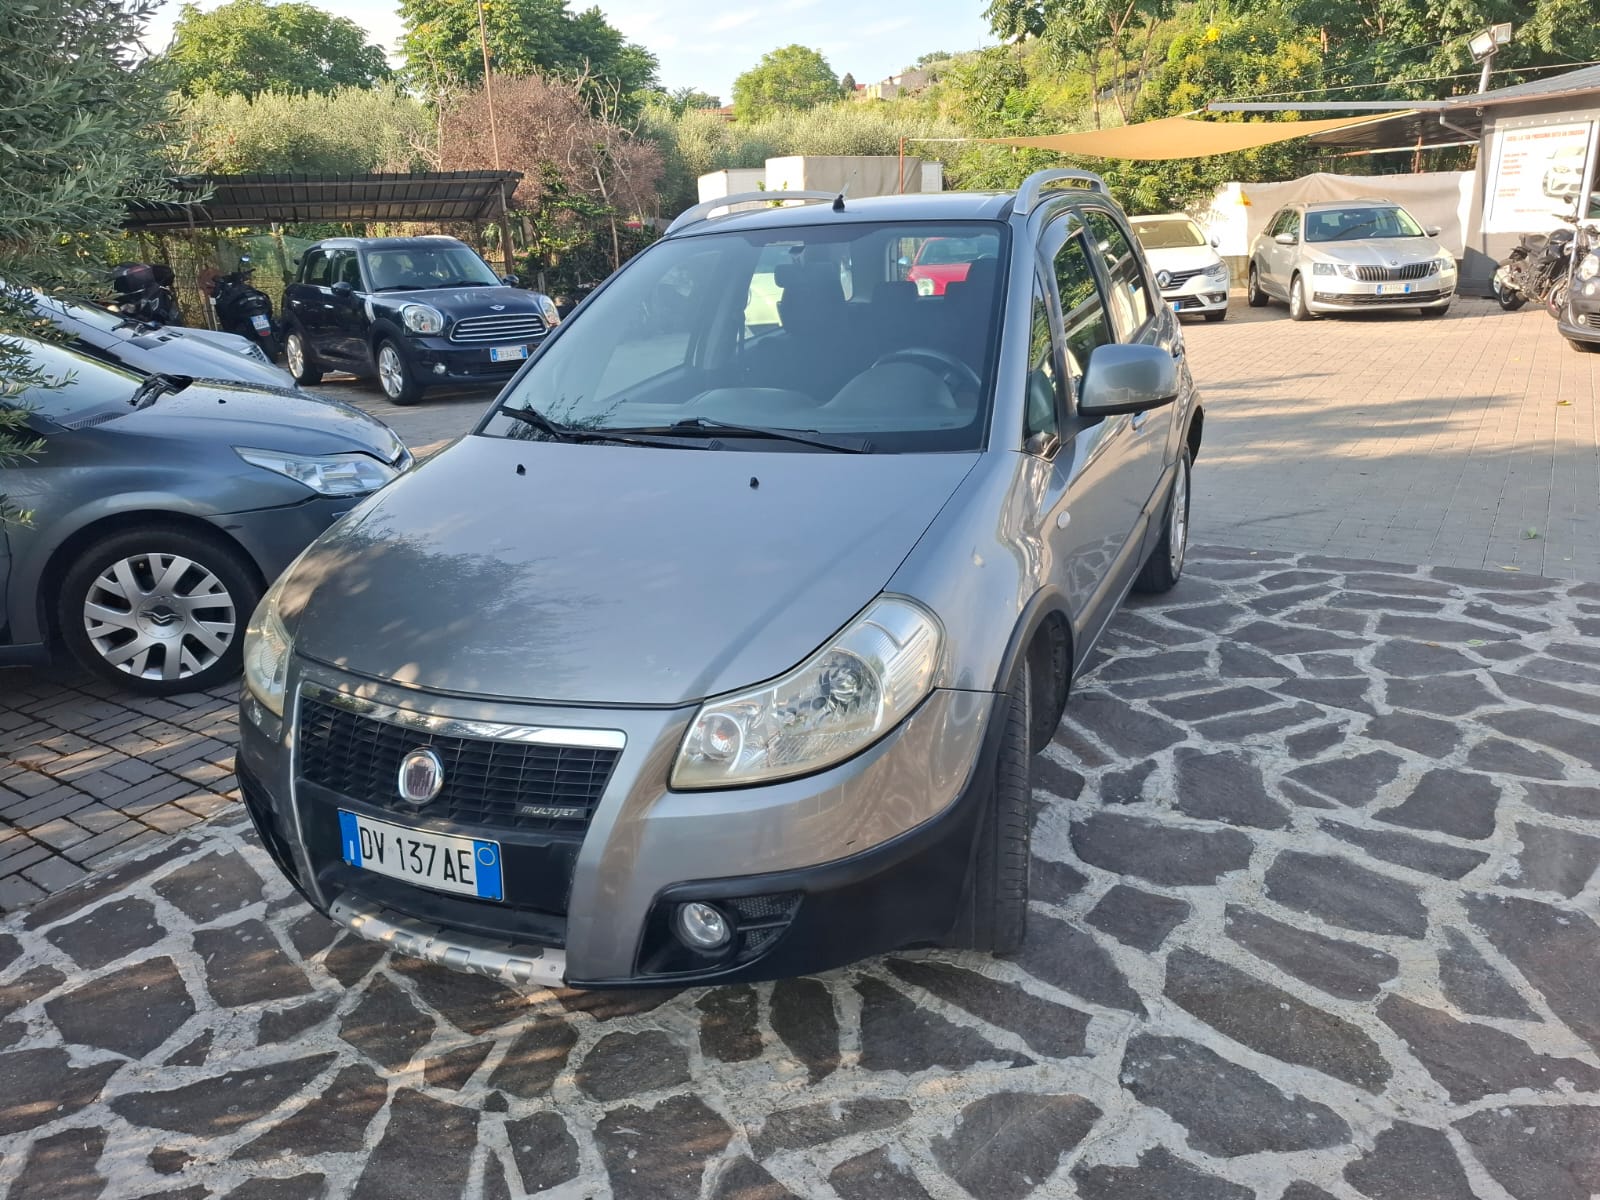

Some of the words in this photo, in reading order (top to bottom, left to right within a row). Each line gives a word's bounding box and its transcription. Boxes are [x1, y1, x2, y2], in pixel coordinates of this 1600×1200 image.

[359, 826, 385, 864] DV
[396, 837, 436, 877] 137
[443, 847, 474, 885] AE
